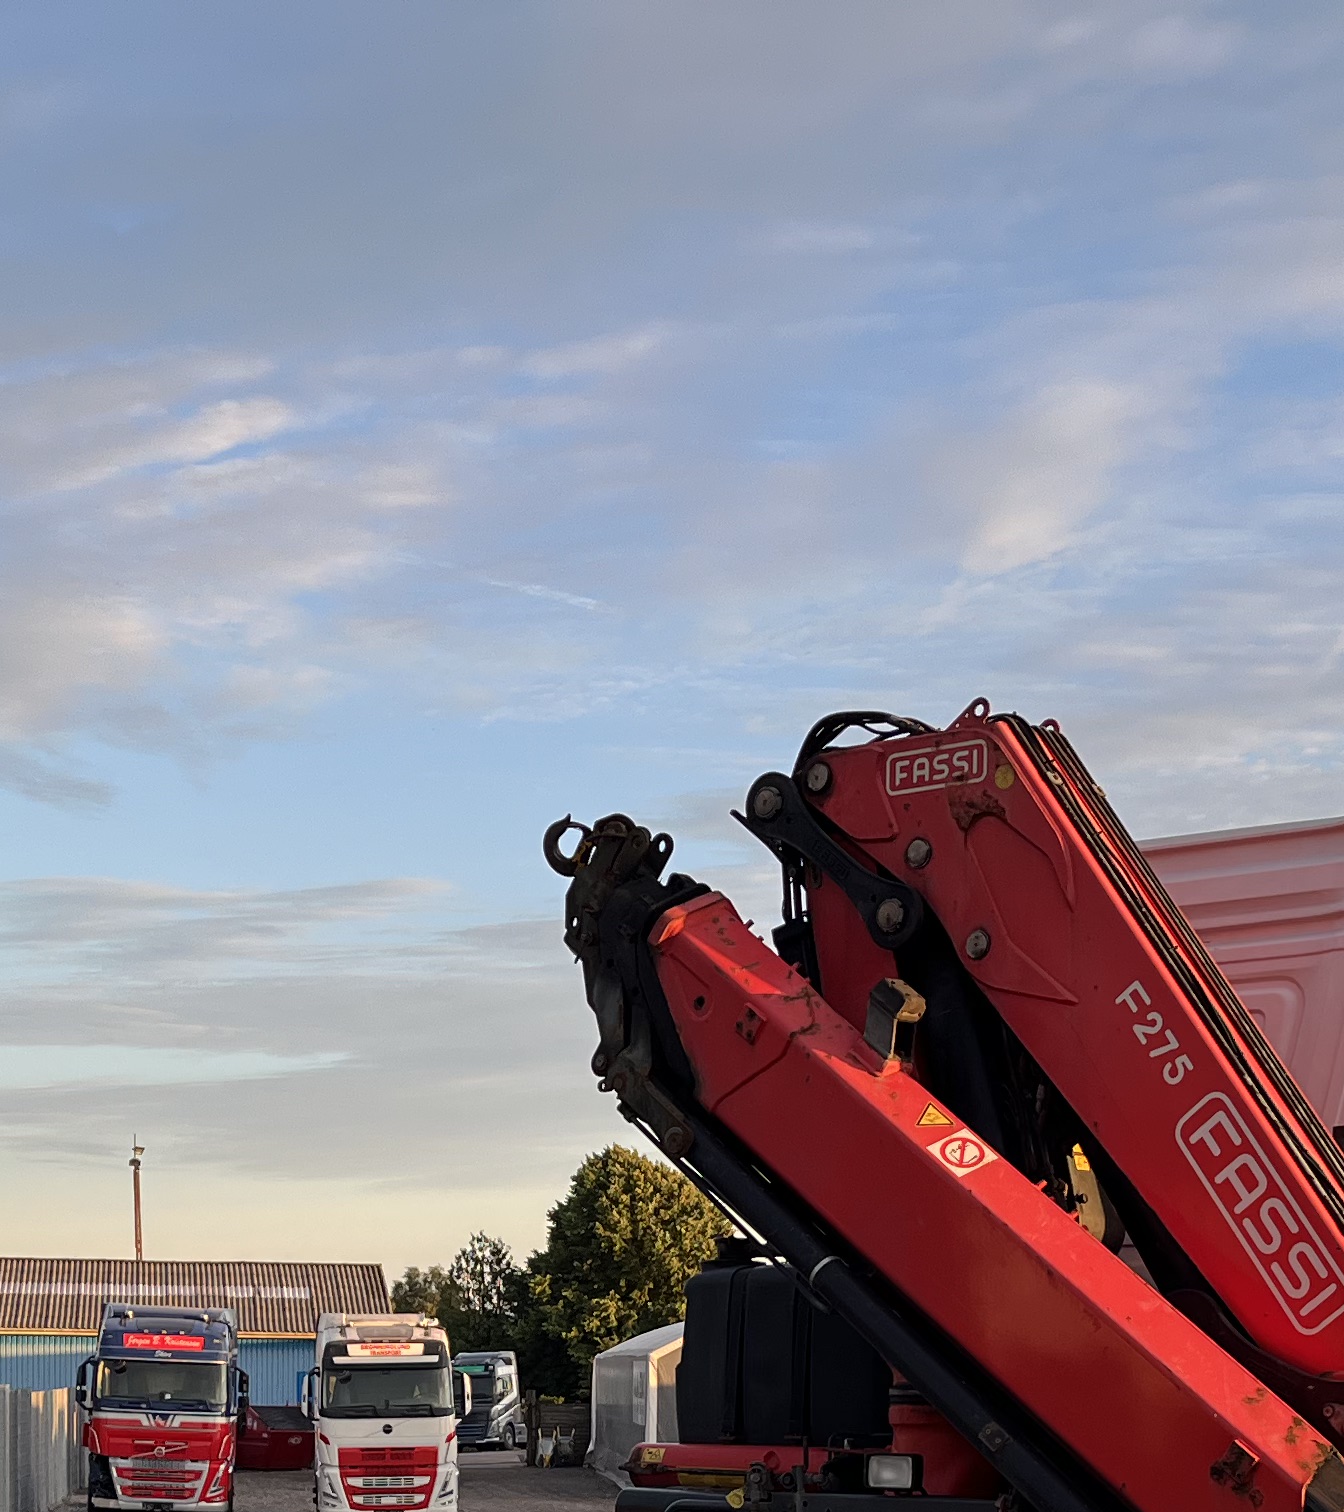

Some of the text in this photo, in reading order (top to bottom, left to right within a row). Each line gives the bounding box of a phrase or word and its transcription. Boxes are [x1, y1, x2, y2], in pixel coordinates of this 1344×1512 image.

[894, 745, 982, 787] FASSI
[1115, 980, 1194, 1086] F275
[1188, 1109, 1337, 1317] FASSI
